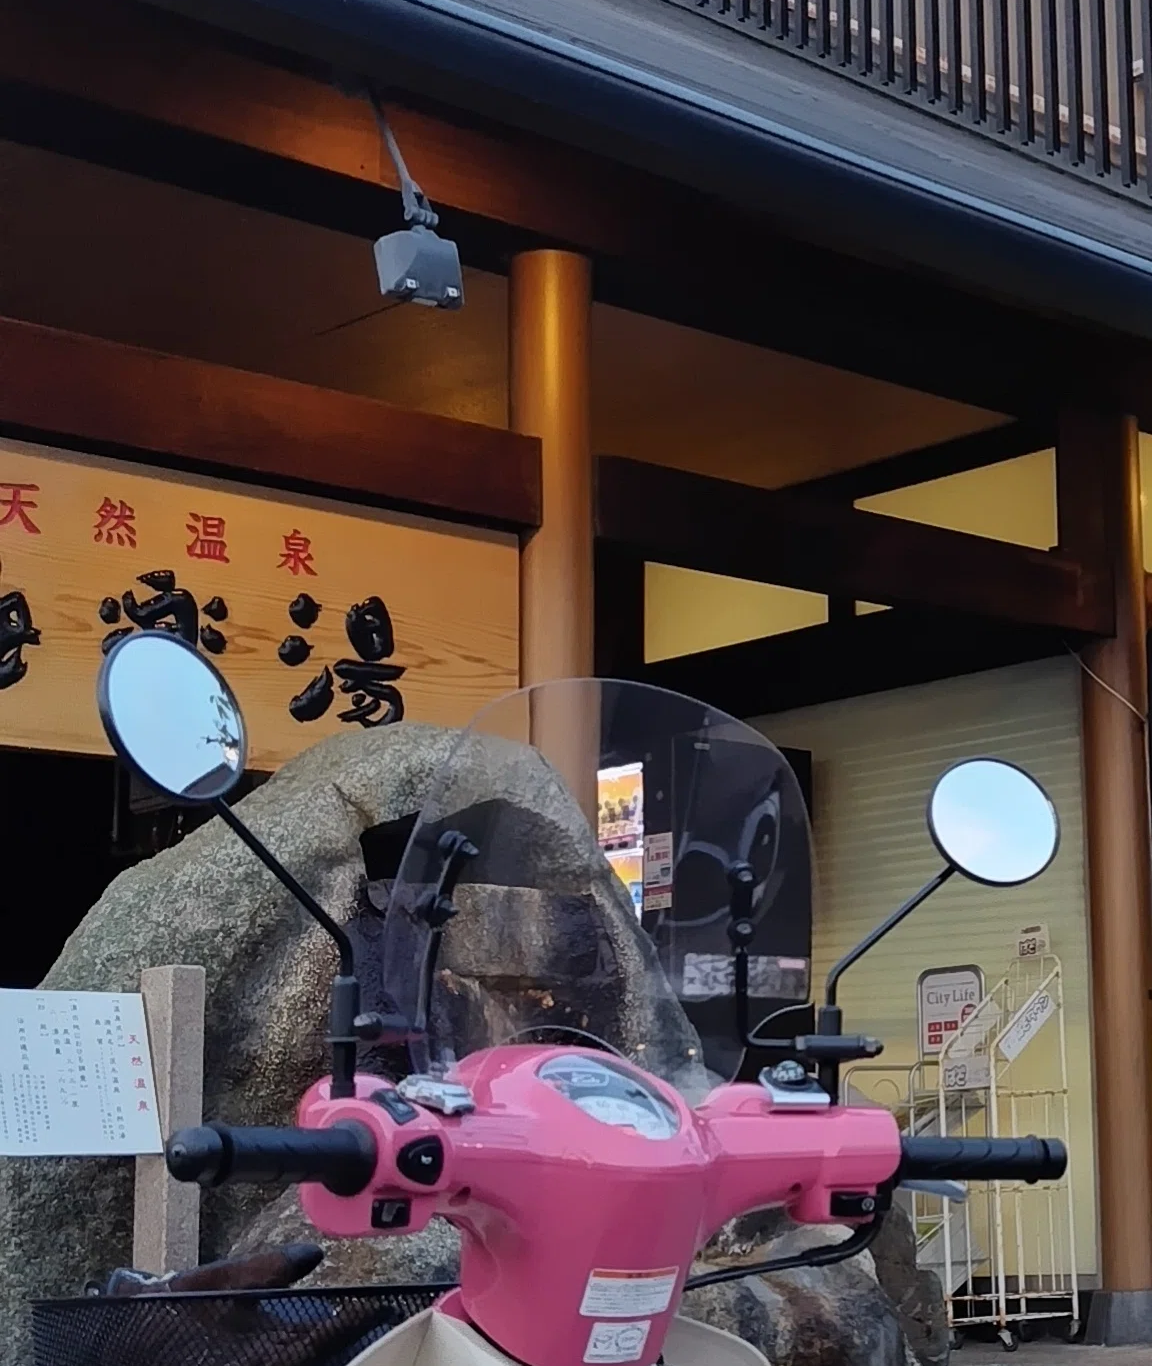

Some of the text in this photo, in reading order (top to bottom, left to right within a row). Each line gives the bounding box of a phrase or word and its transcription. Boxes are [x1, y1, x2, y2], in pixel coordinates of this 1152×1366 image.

[0, 482, 318, 577] 天然温泉
[926, 989, 976, 1008] City Life
